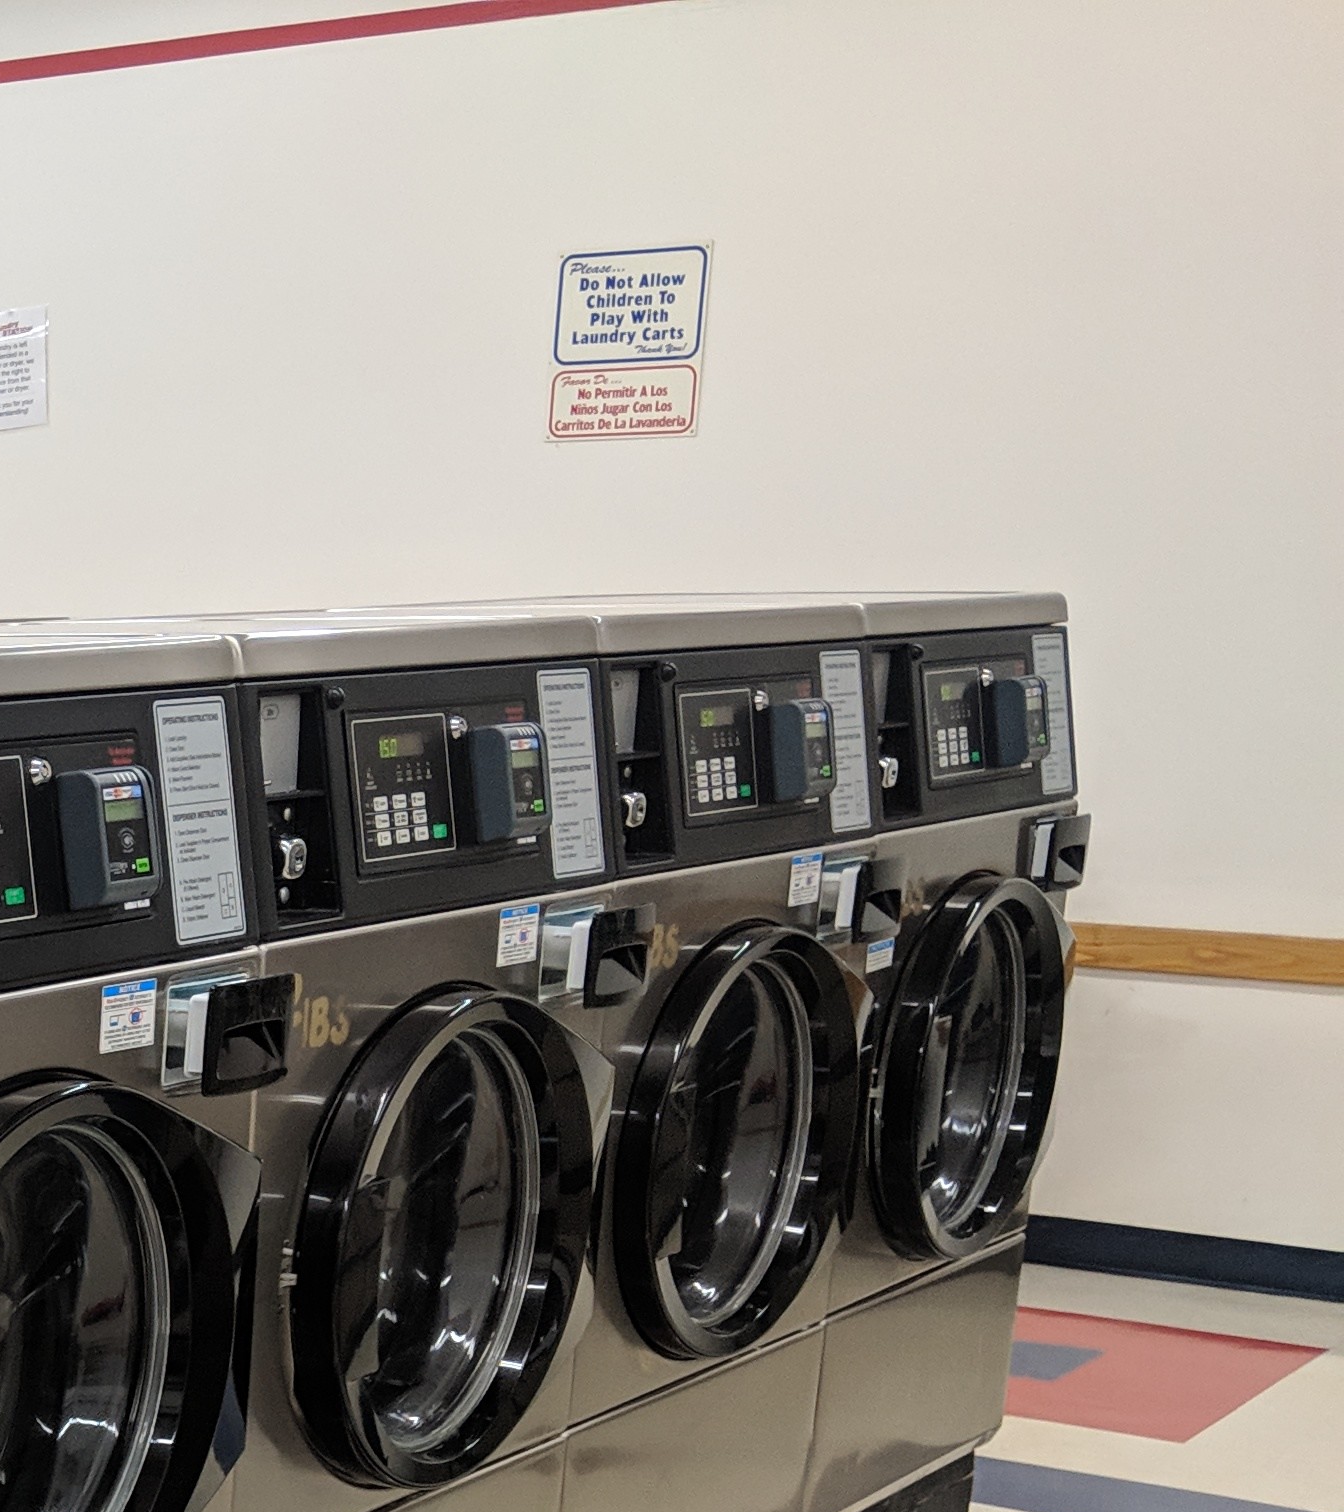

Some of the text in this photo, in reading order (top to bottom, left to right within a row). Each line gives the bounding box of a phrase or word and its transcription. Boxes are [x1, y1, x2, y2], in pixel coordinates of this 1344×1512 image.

[579, 273, 685, 291] Do Not Allow
[587, 290, 675, 309] Children To
[590, 309, 668, 329] Play With
[572, 327, 684, 346] Laundry Carts
[635, 345, 663, 354] Thank
[561, 375, 591, 388] Favor
[577, 386, 667, 400] No Permitir A Los
[570, 401, 672, 416] Niños Jugar Con Los
[555, 420, 594, 431] Carritos
[598, 419, 611, 429] De
[614, 418, 626, 428] La
